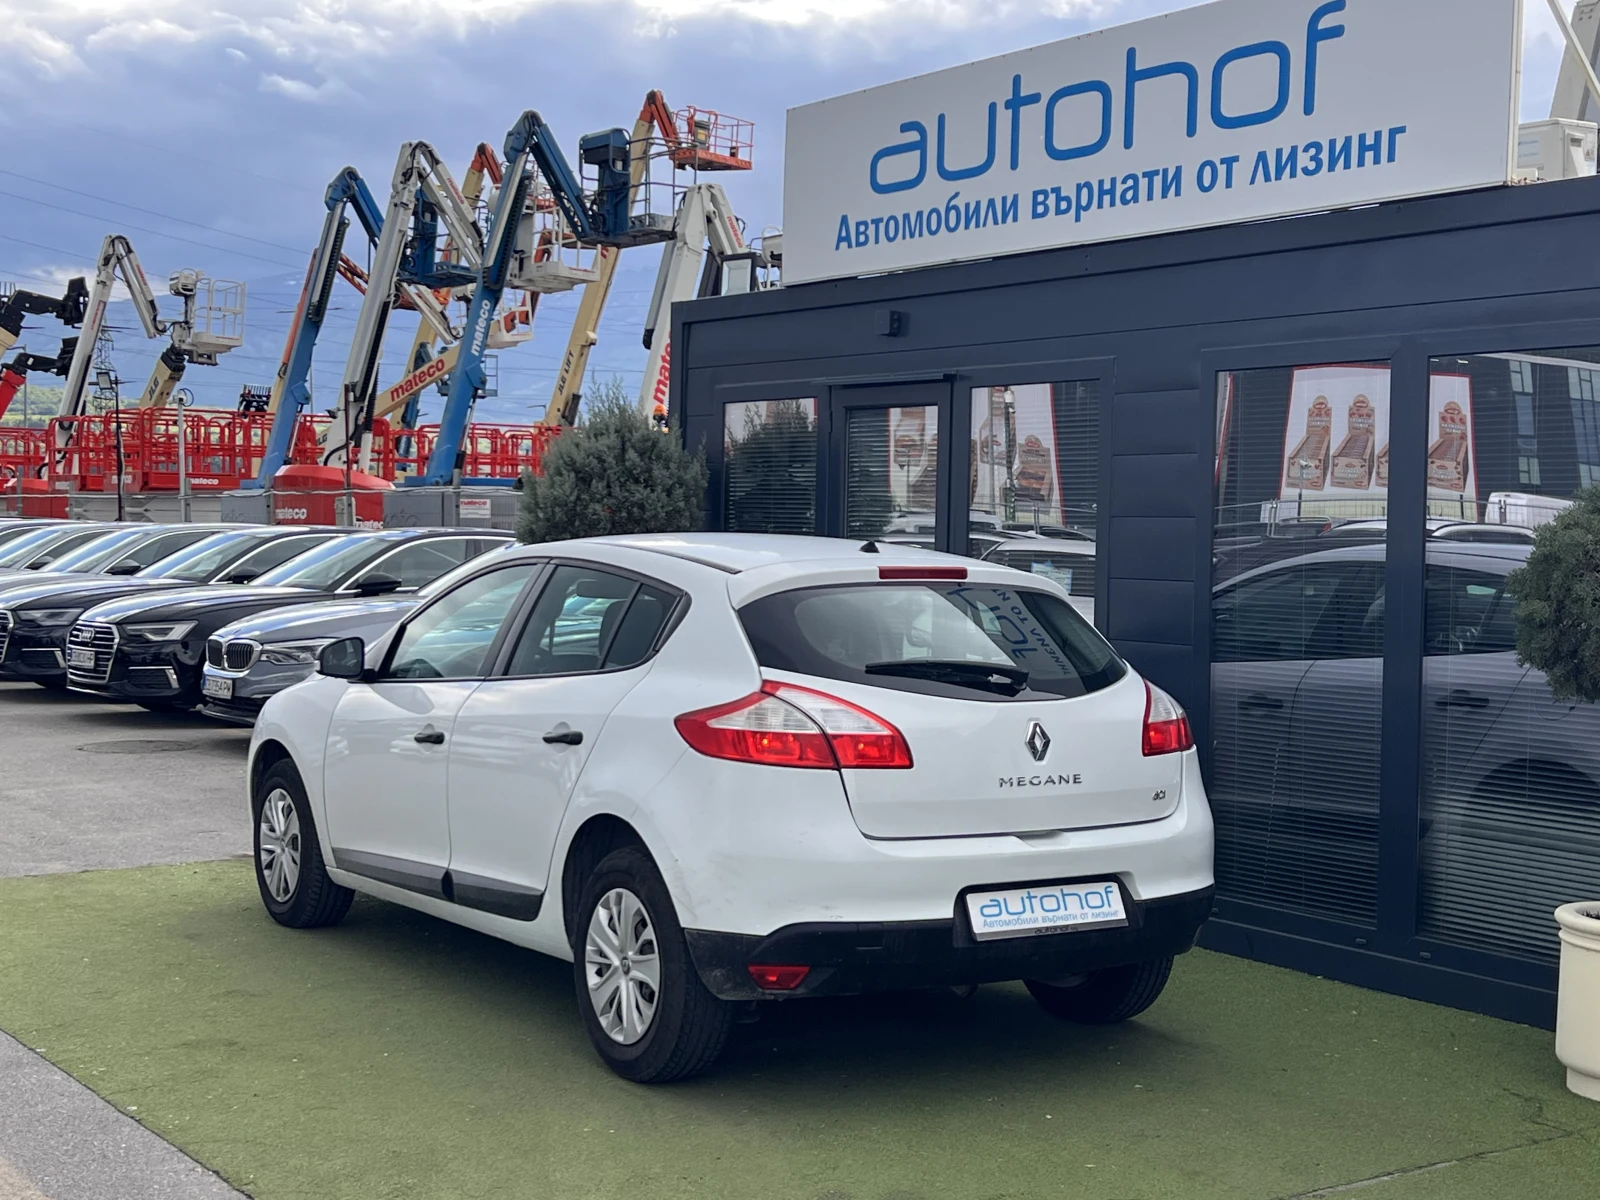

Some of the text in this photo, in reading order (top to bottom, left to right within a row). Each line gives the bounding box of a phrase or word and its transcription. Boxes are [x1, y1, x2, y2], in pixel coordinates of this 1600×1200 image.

[870, 0, 1346, 194] autohof
[835, 125, 1407, 251] Автомобили върнати от лизинг
[726, 215, 743, 249] mateco
[471, 300, 491, 356] mateco
[564, 350, 574, 374] LIFT
[390, 359, 445, 403] mateco
[999, 773, 1083, 788] MEGANE
[980, 885, 1113, 918] autohof
[983, 910, 1120, 929] Автомобили върнати от лизинг
